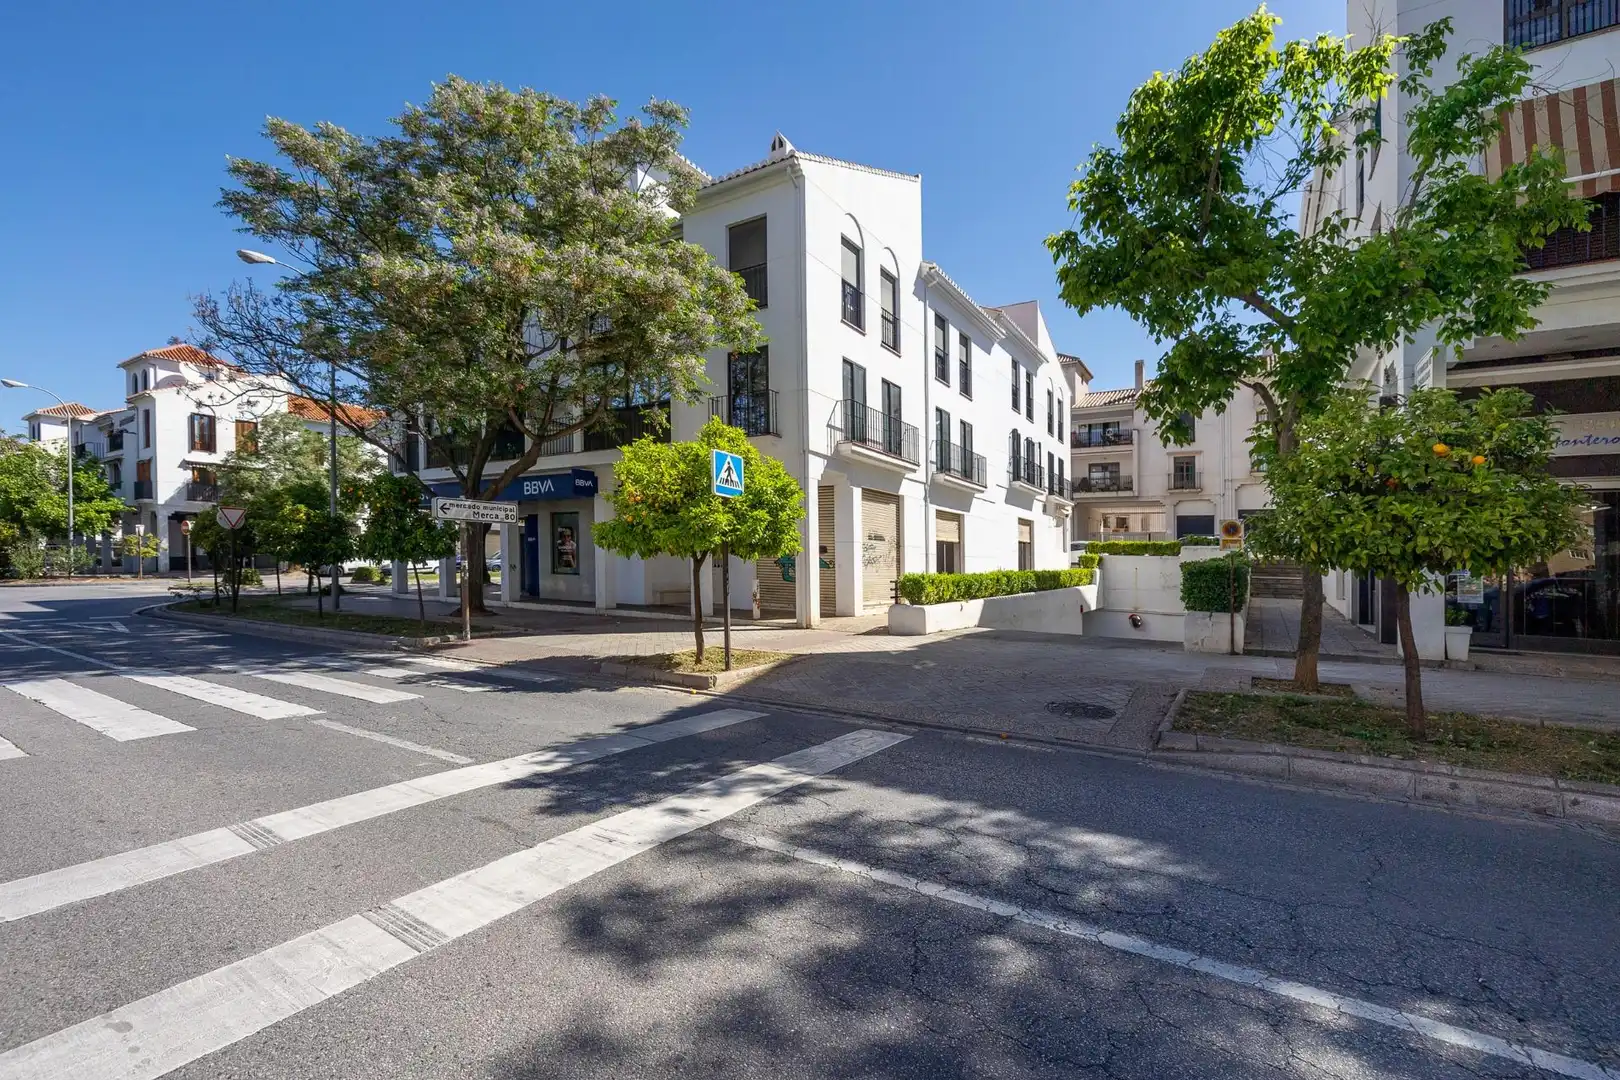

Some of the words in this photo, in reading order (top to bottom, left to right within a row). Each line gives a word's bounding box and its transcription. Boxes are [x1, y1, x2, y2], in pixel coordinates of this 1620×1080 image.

[523, 478, 555, 495] BBVA
[575, 479, 593, 487] BBVA
[449, 502, 480, 510] mercado
[482, 505, 515, 513] municipal
[472, 511, 499, 519] Merca
[504, 513, 516, 521] 80
